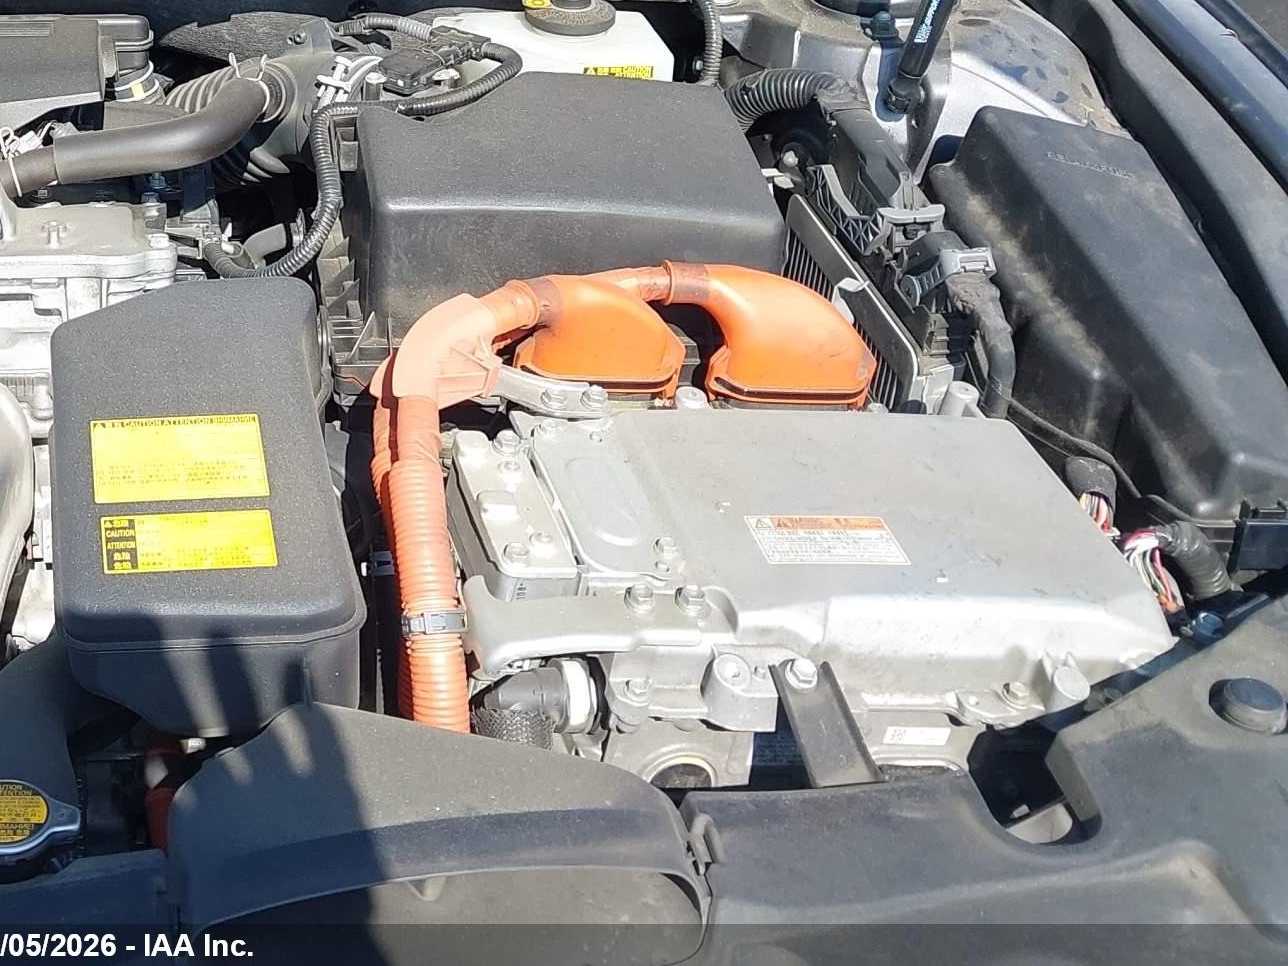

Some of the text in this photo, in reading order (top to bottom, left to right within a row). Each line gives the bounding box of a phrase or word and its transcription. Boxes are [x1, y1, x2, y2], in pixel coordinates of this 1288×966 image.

[124, 420, 161, 428] CAUTION
[164, 418, 211, 426] ATTENTION
[106, 529, 135, 538] CAUTION
[107, 541, 136, 549] ATTENTION
